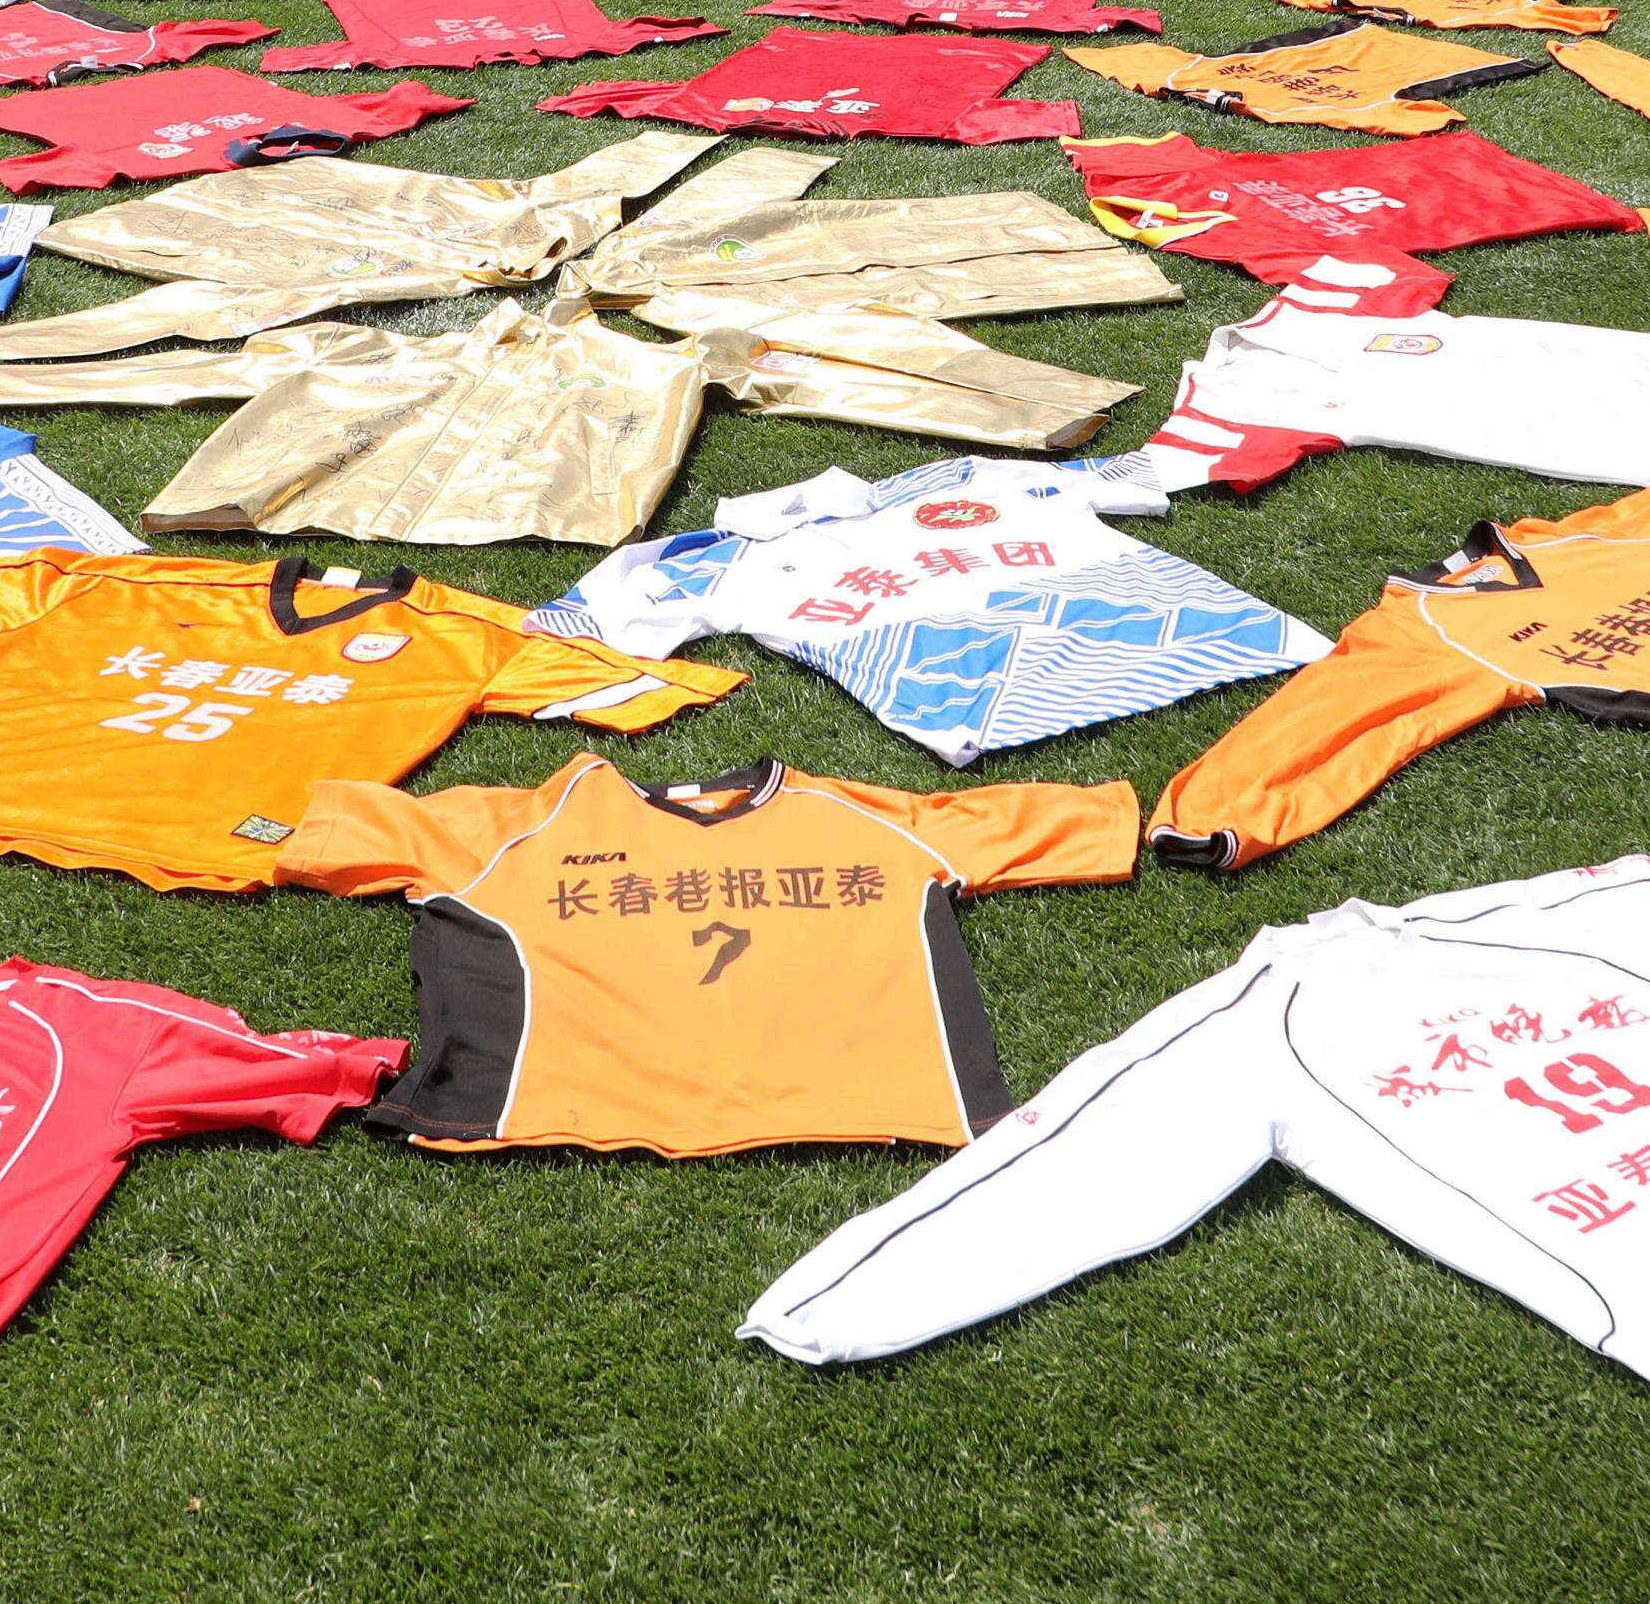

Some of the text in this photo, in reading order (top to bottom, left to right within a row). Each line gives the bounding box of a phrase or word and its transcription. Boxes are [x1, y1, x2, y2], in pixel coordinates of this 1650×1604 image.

[785, 540, 1058, 628] 亚泰集团
[1508, 620, 1549, 645] KIKA
[99, 644, 357, 708] 长春亚泰
[98, 690, 261, 745] 25
[561, 851, 627, 865] KIKA
[546, 863, 888, 921] 长春巷报亚泰
[689, 921, 753, 986] 7
